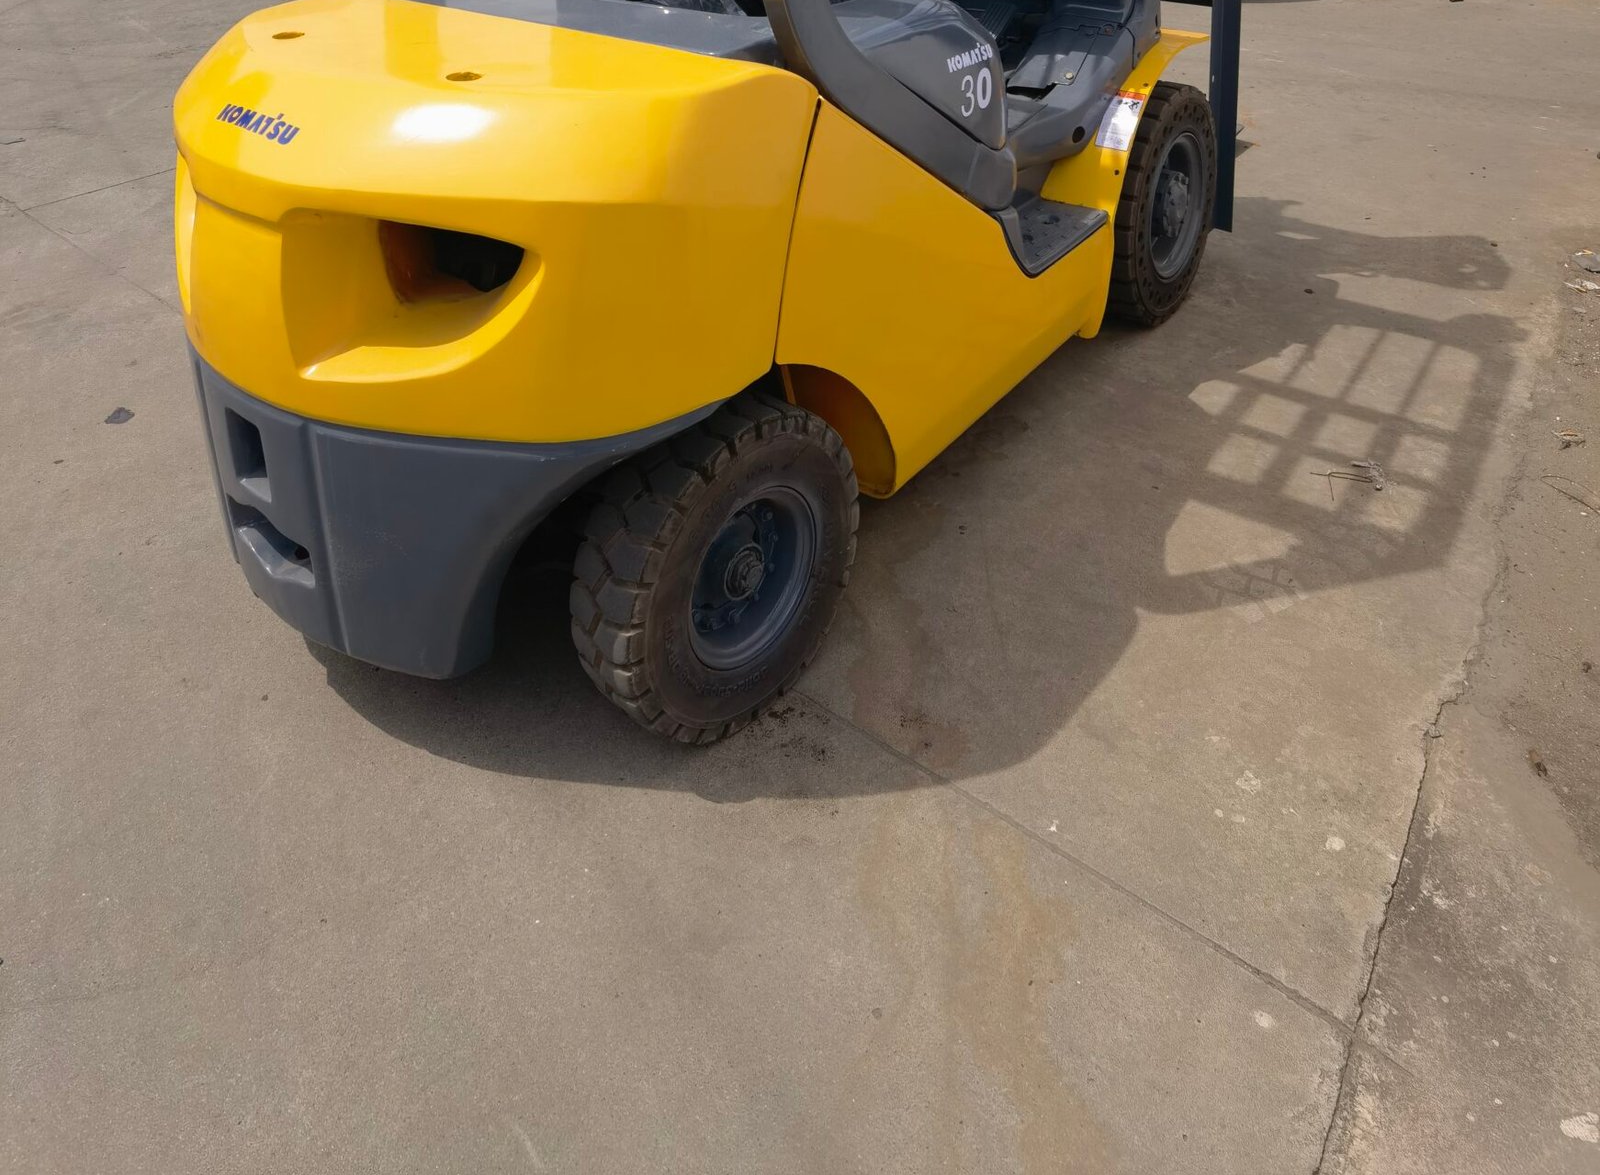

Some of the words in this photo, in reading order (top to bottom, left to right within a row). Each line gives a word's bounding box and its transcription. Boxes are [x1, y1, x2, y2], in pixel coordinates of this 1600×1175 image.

[946, 42, 994, 73] KOMATSU
[961, 67, 992, 117] 30
[216, 102, 300, 145] KOMATSU
